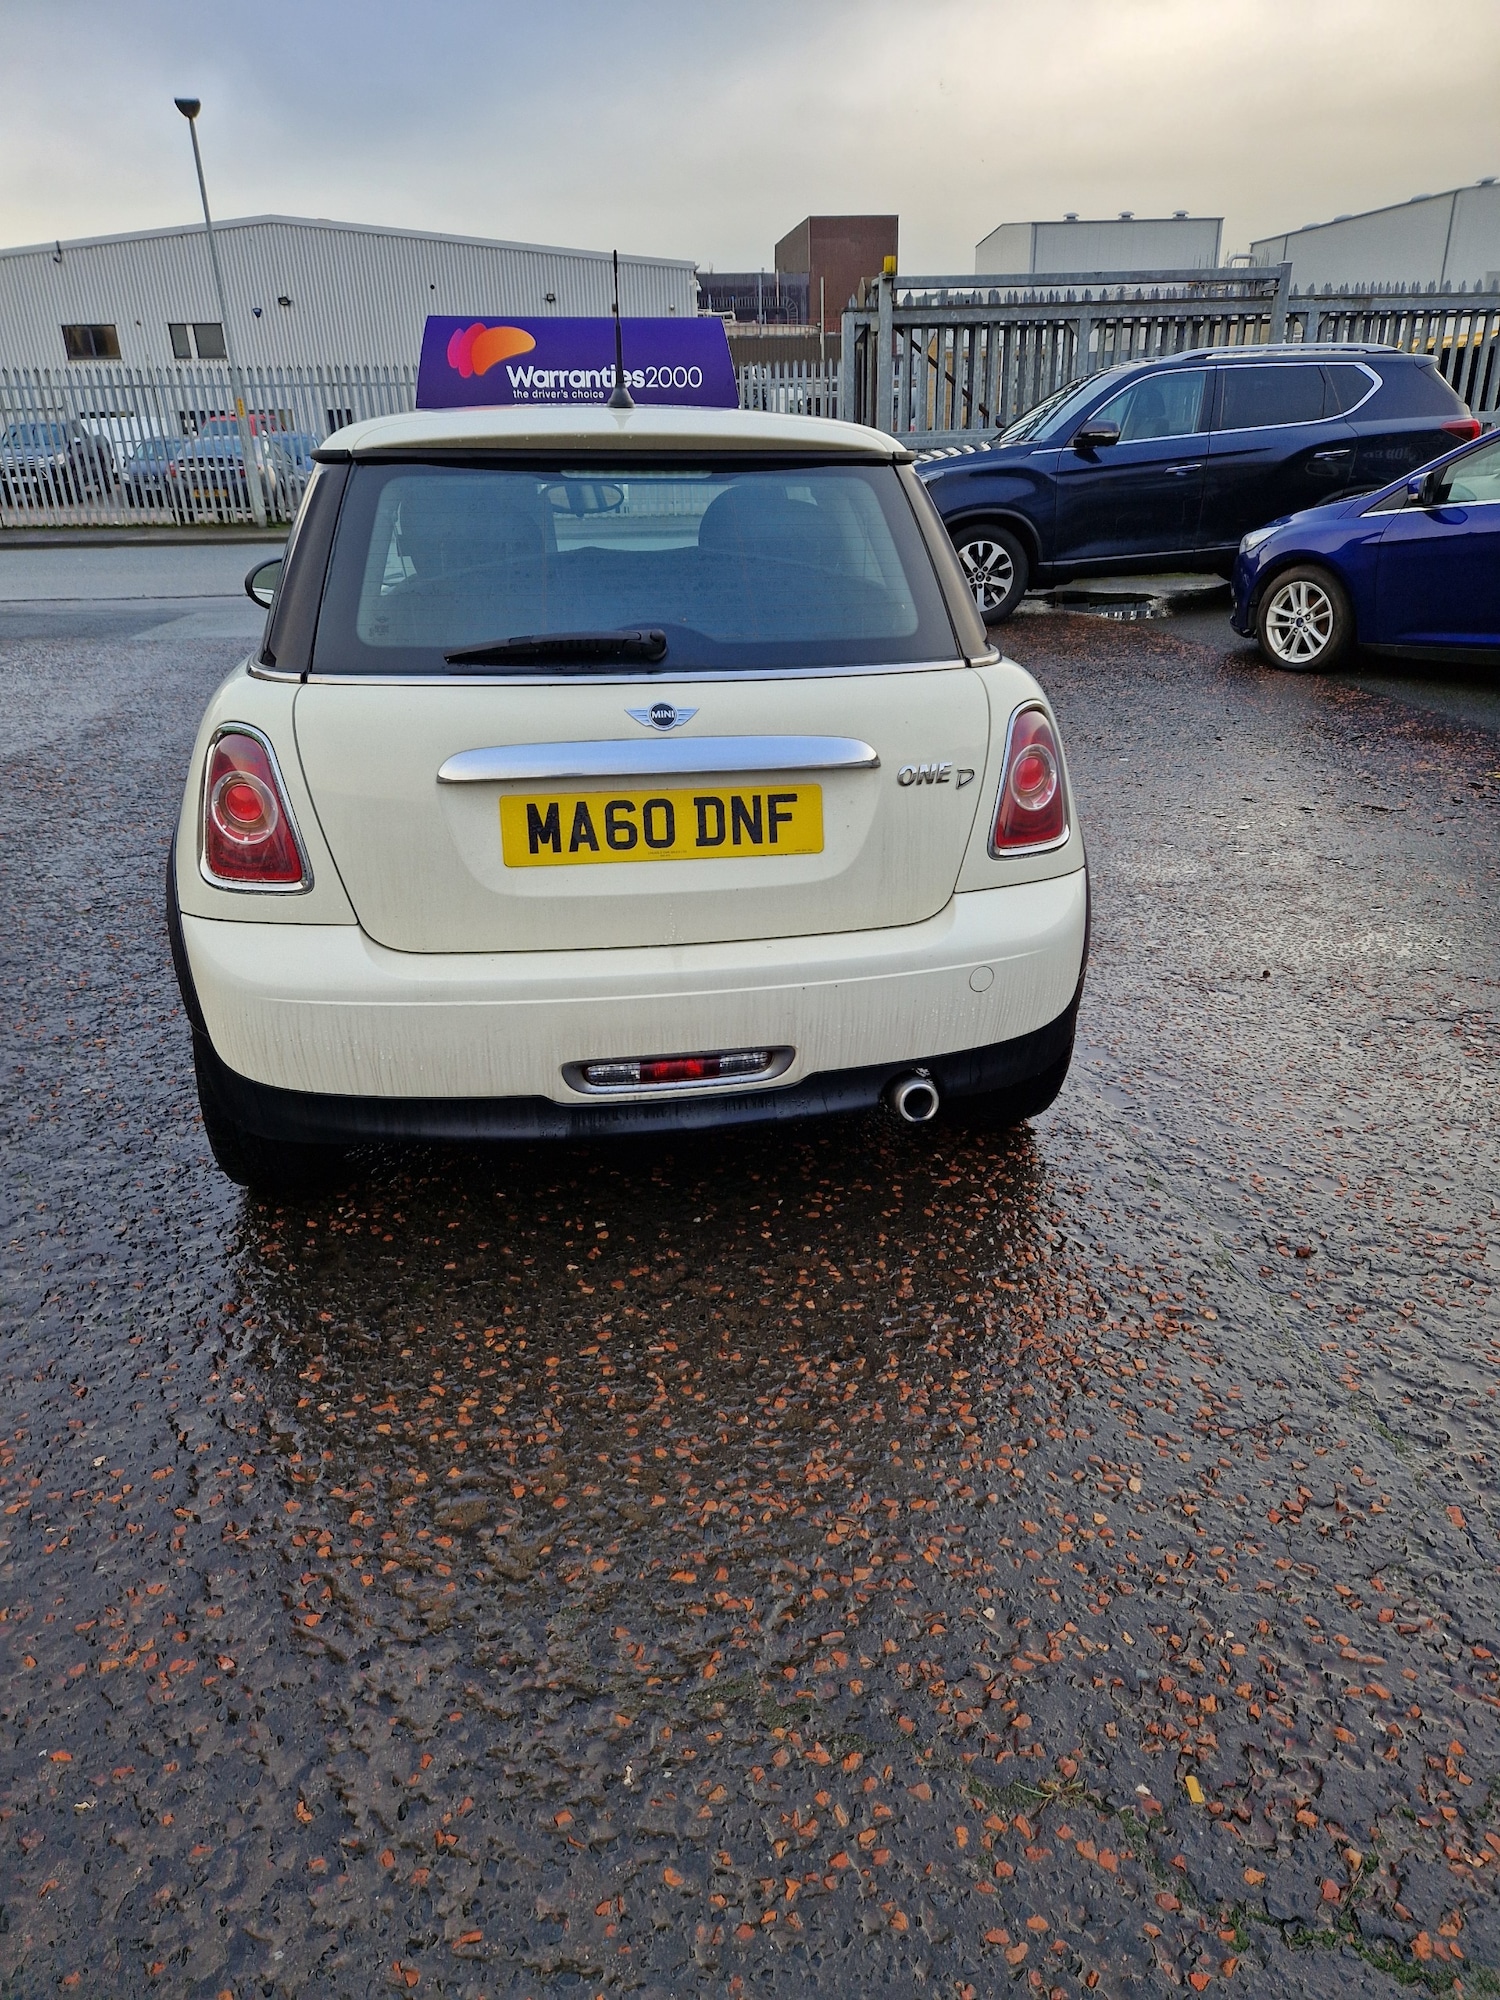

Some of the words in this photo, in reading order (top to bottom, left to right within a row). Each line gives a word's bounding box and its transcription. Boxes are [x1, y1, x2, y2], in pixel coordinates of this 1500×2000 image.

[513, 390, 529, 398] the
[532, 390, 568, 398] driver's
[572, 390, 604, 398] choice
[652, 710, 674, 718] MINI
[897, 762, 952, 786] ONE
[956, 769, 975, 790] D
[526, 798, 676, 854] MA60
[693, 793, 798, 847] DNF
